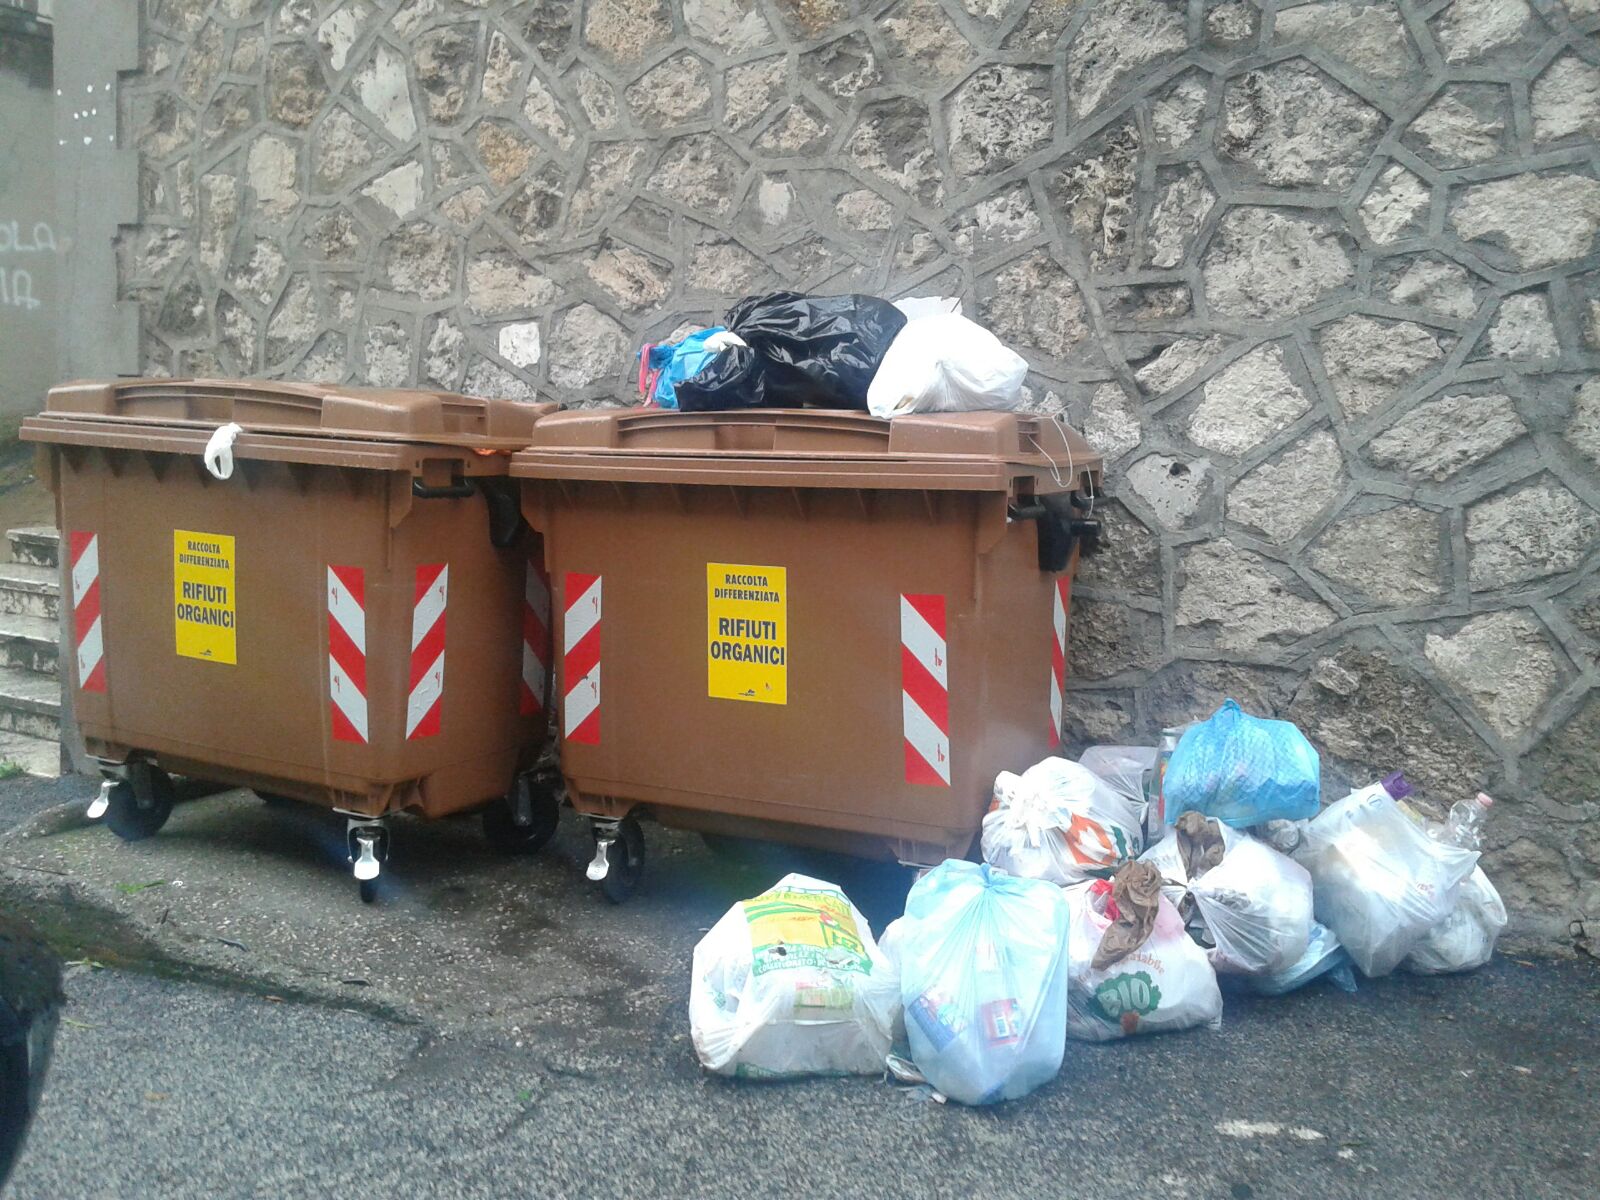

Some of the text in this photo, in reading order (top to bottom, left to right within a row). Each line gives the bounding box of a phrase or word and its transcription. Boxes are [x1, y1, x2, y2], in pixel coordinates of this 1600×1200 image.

[187, 540, 220, 554] RACCOLTA
[179, 553, 229, 570] DIFFERENZIATA
[725, 573, 768, 587] RACCOLTA
[183, 581, 227, 604] RIFIUTI
[714, 588, 780, 603] DIFFERENZIATA
[177, 602, 234, 628] ORGANICI
[718, 617, 776, 640] RIFIUTI
[710, 640, 785, 666] ORGANICI
